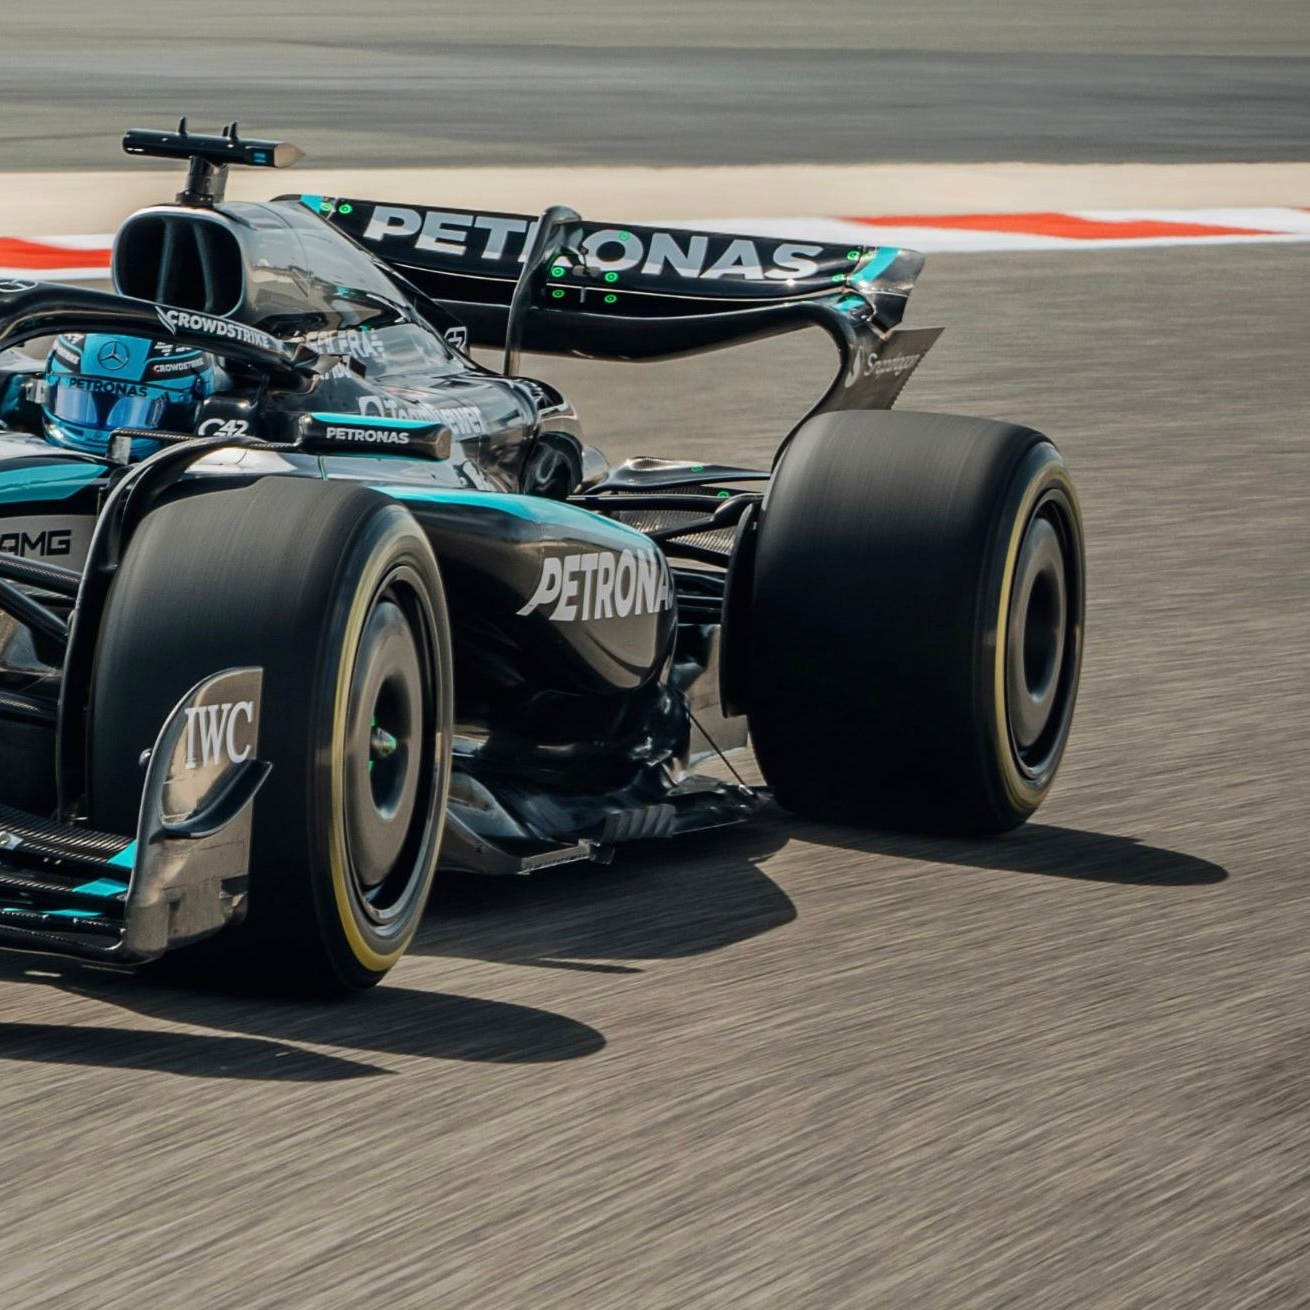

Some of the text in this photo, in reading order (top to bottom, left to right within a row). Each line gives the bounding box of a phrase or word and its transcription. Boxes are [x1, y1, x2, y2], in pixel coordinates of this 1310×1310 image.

[363, 204, 825, 280] PETONAS
[166, 310, 270, 349] CROWDSTRIKE
[70, 377, 148, 398] PETRONAS
[326, 427, 410, 445] PETRONAS
[516, 548, 675, 621] PETRONA
[184, 701, 254, 770] IWC
